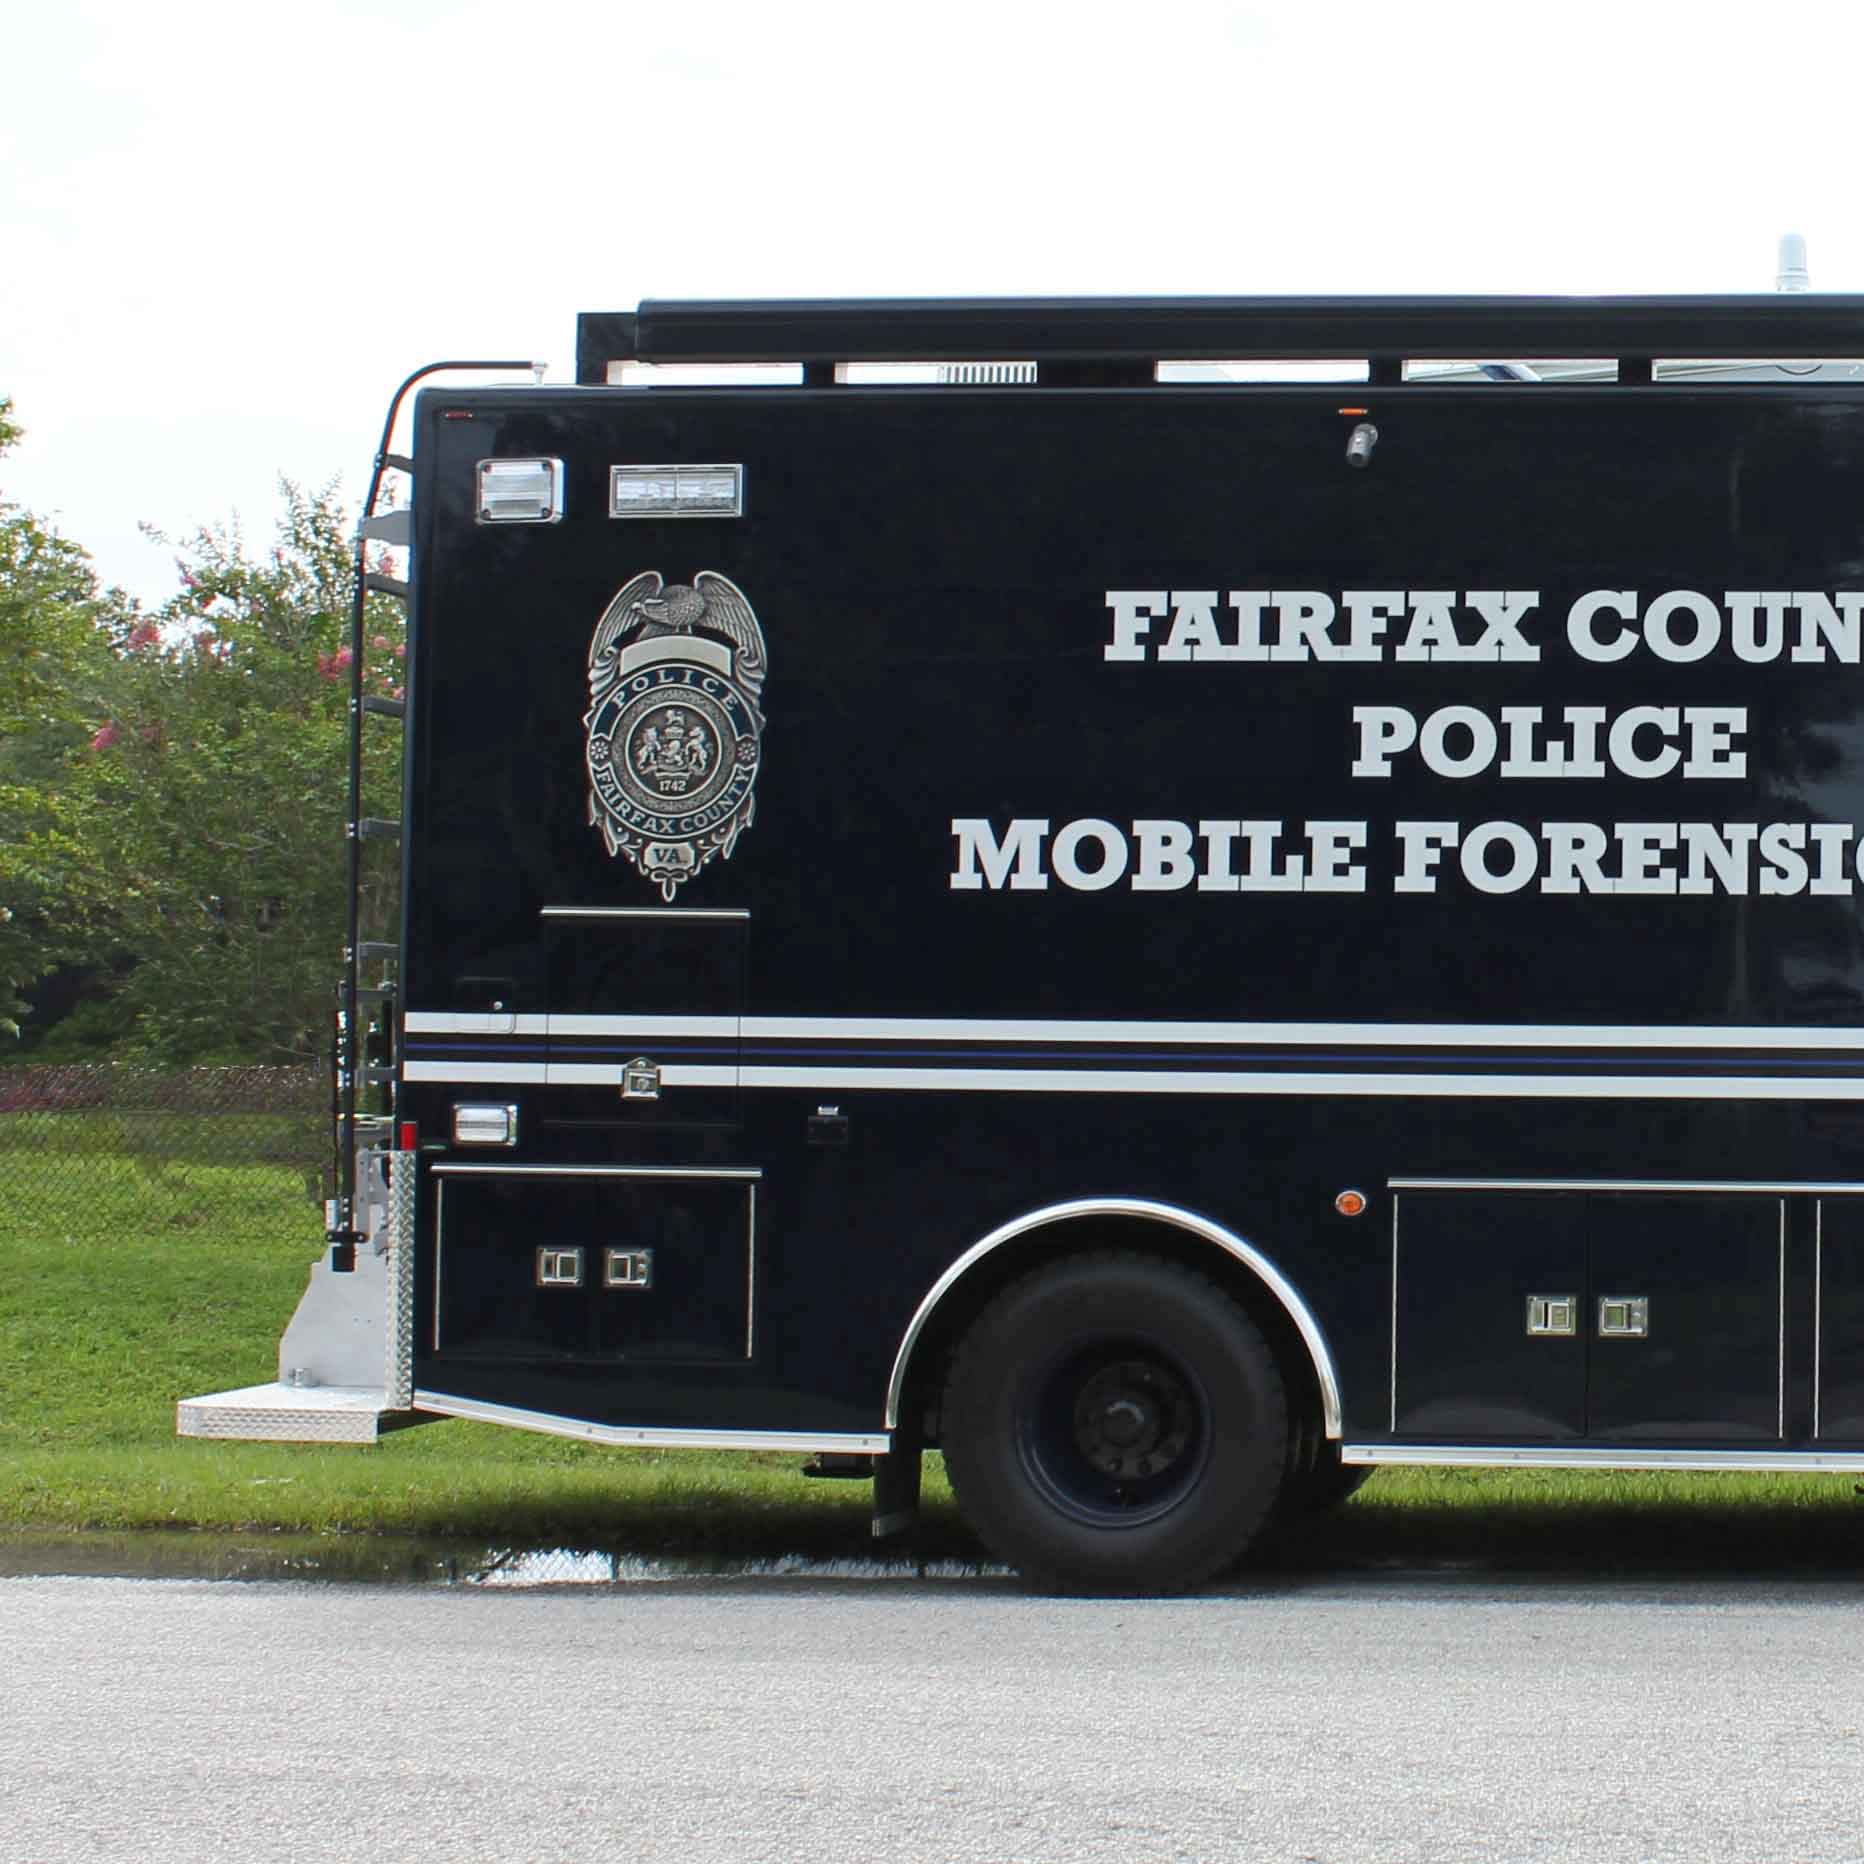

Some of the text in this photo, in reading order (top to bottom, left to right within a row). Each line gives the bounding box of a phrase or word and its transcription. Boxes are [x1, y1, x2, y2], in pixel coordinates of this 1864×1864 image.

[1104, 590, 1541, 662] FAIRFAX
[612, 669, 738, 711] POLICE
[1351, 705, 1748, 779] POLICE
[596, 769, 749, 833] FAIRFAX COUNTY
[659, 780, 687, 792] 1742
[950, 818, 1368, 892] MOBILE
